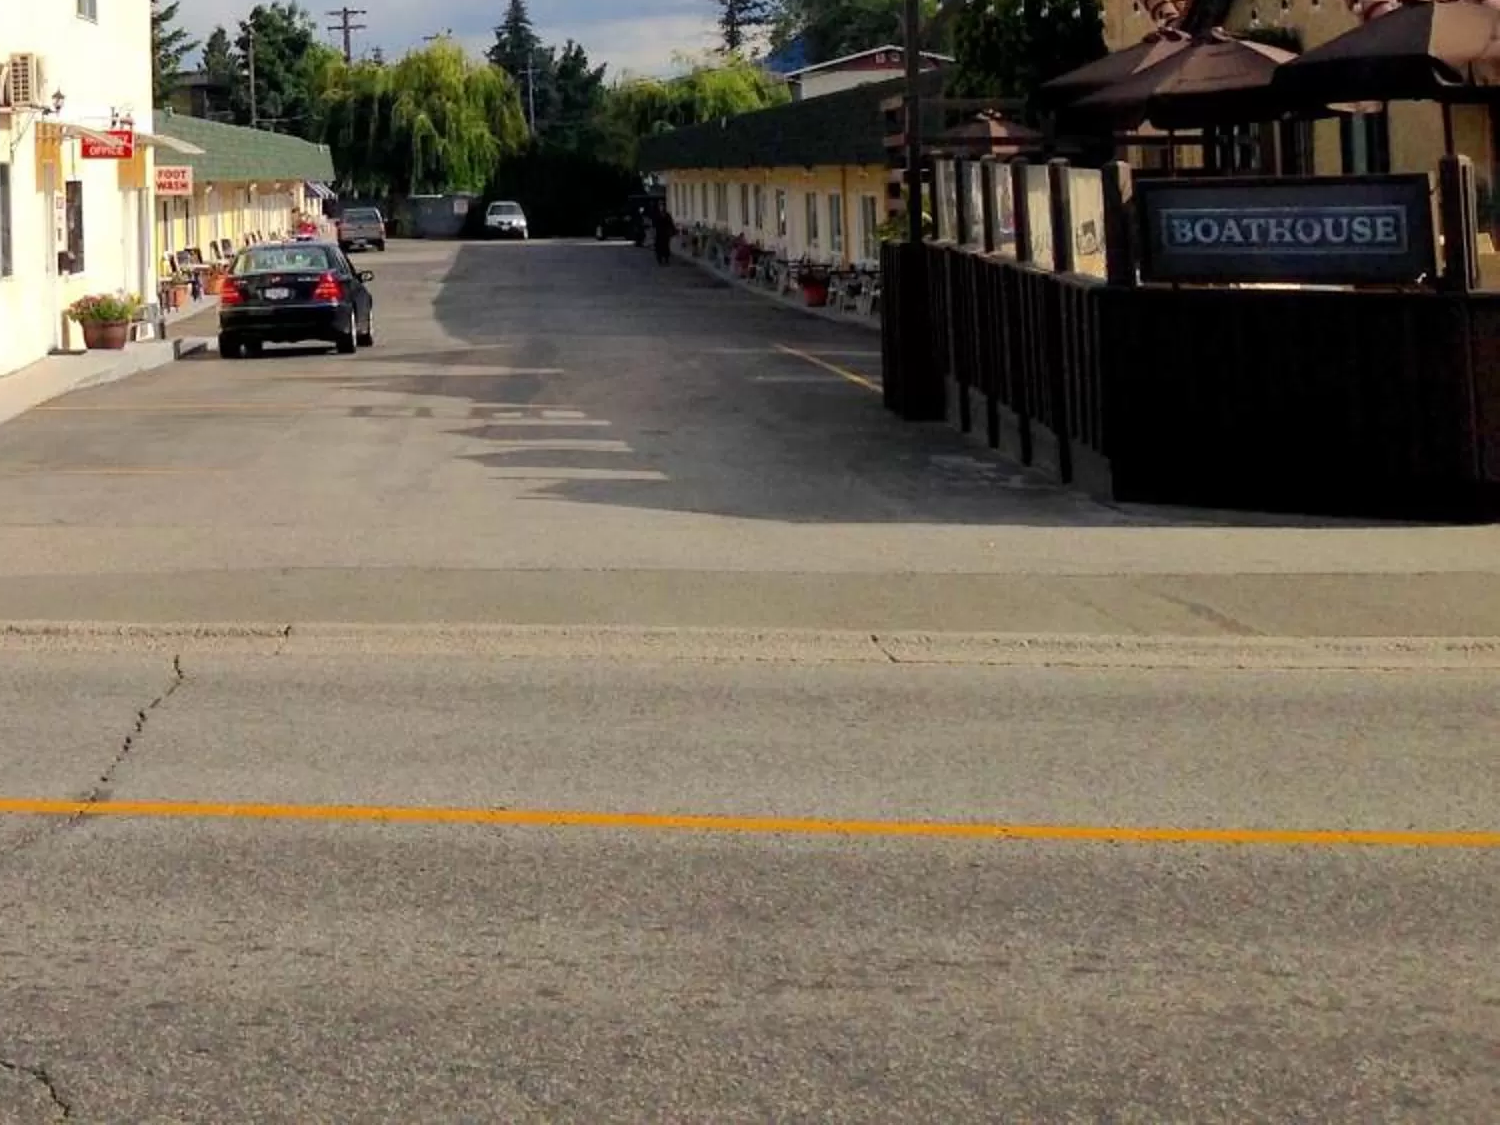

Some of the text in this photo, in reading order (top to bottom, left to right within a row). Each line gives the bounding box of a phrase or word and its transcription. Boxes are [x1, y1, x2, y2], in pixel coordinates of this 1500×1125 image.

[89, 146, 125, 156] OFFICE
[158, 170, 187, 179] FOOT
[156, 181, 188, 191] WASH
[1171, 215, 1398, 244] BOATHOUSE
